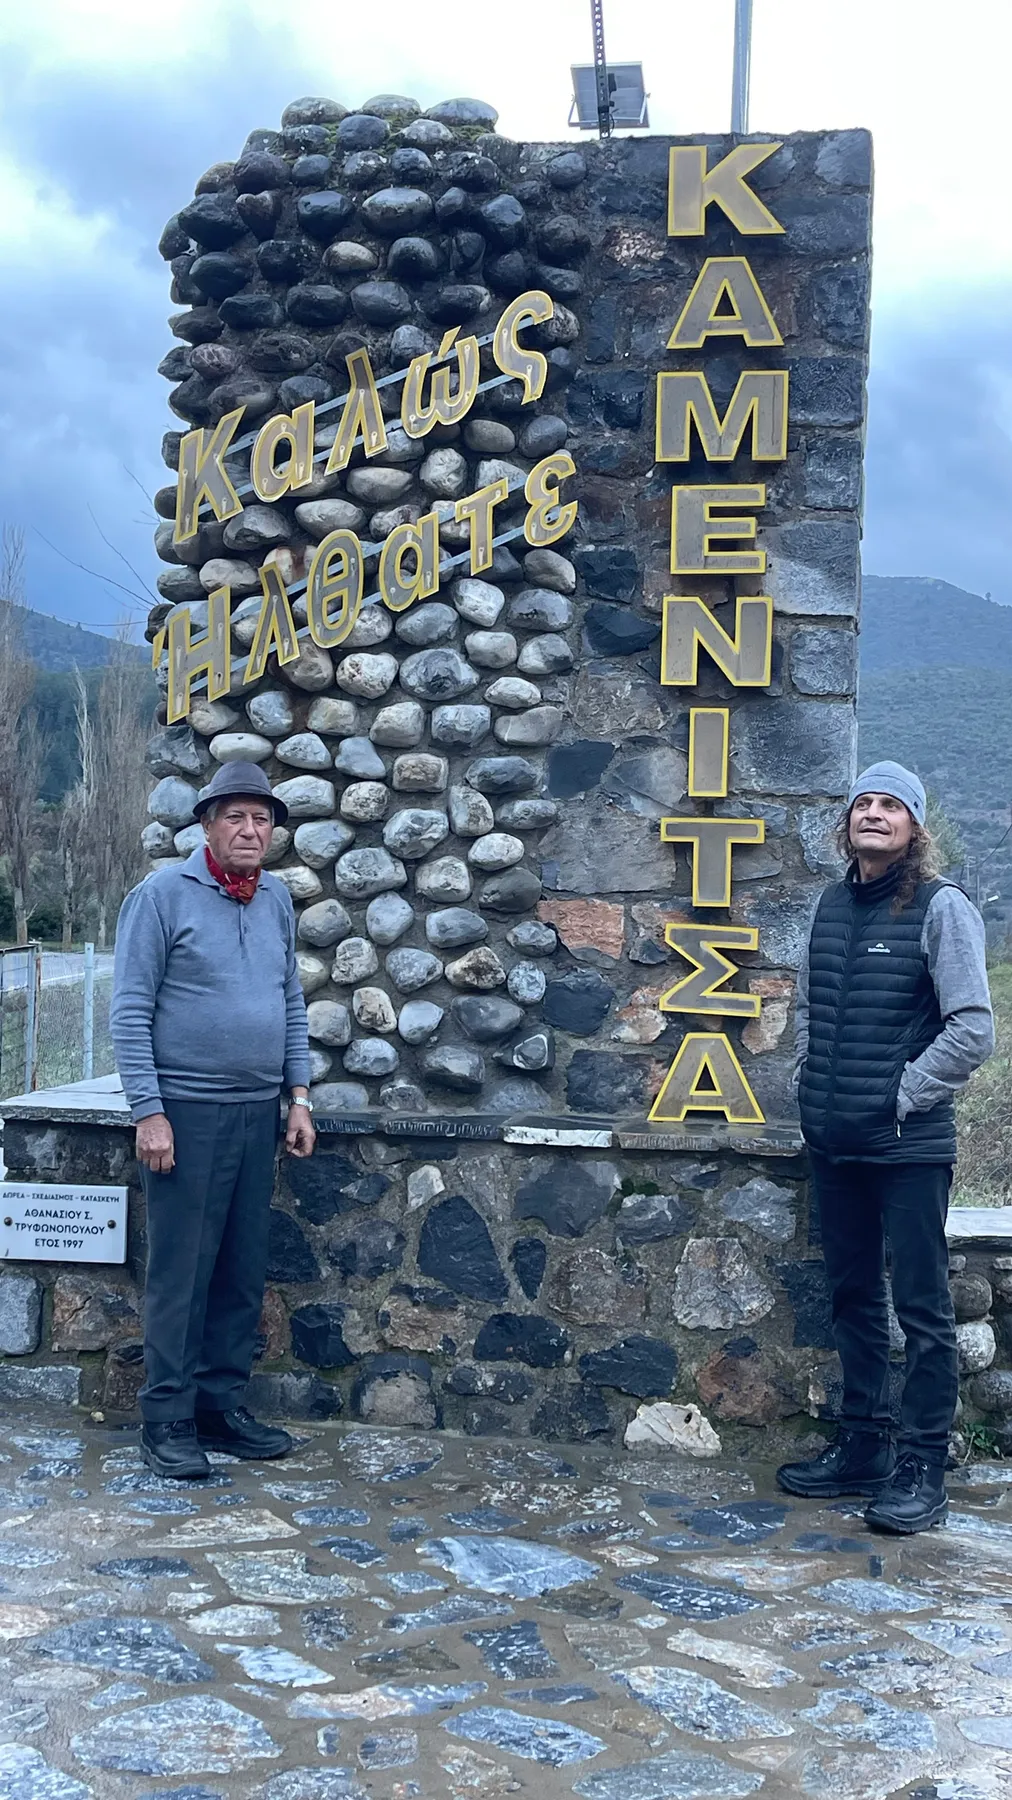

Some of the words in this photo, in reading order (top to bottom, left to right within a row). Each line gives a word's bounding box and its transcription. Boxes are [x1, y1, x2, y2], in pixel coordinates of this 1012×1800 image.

[174, 289, 554, 544] Καλώς
[646, 141, 789, 1123] ΚΑΜΕΝΙΤΣΑ
[31, 1193, 74, 1201] ΣΧΕΔΙΑΣΜΟΣ
[80, 1195, 120, 1203] ΚΑΤΑΣΚΕΥΗ
[24, 1208, 82, 1219] ΑΘΑΝΑΣΙΟΥ
[15, 1222, 105, 1235] ΤΡΥΦΩΝΟΠΟΥΛΟΥ
[34, 1238, 60, 1248] ΕΤΟΣ
[63, 1239, 84, 1248] 1997
